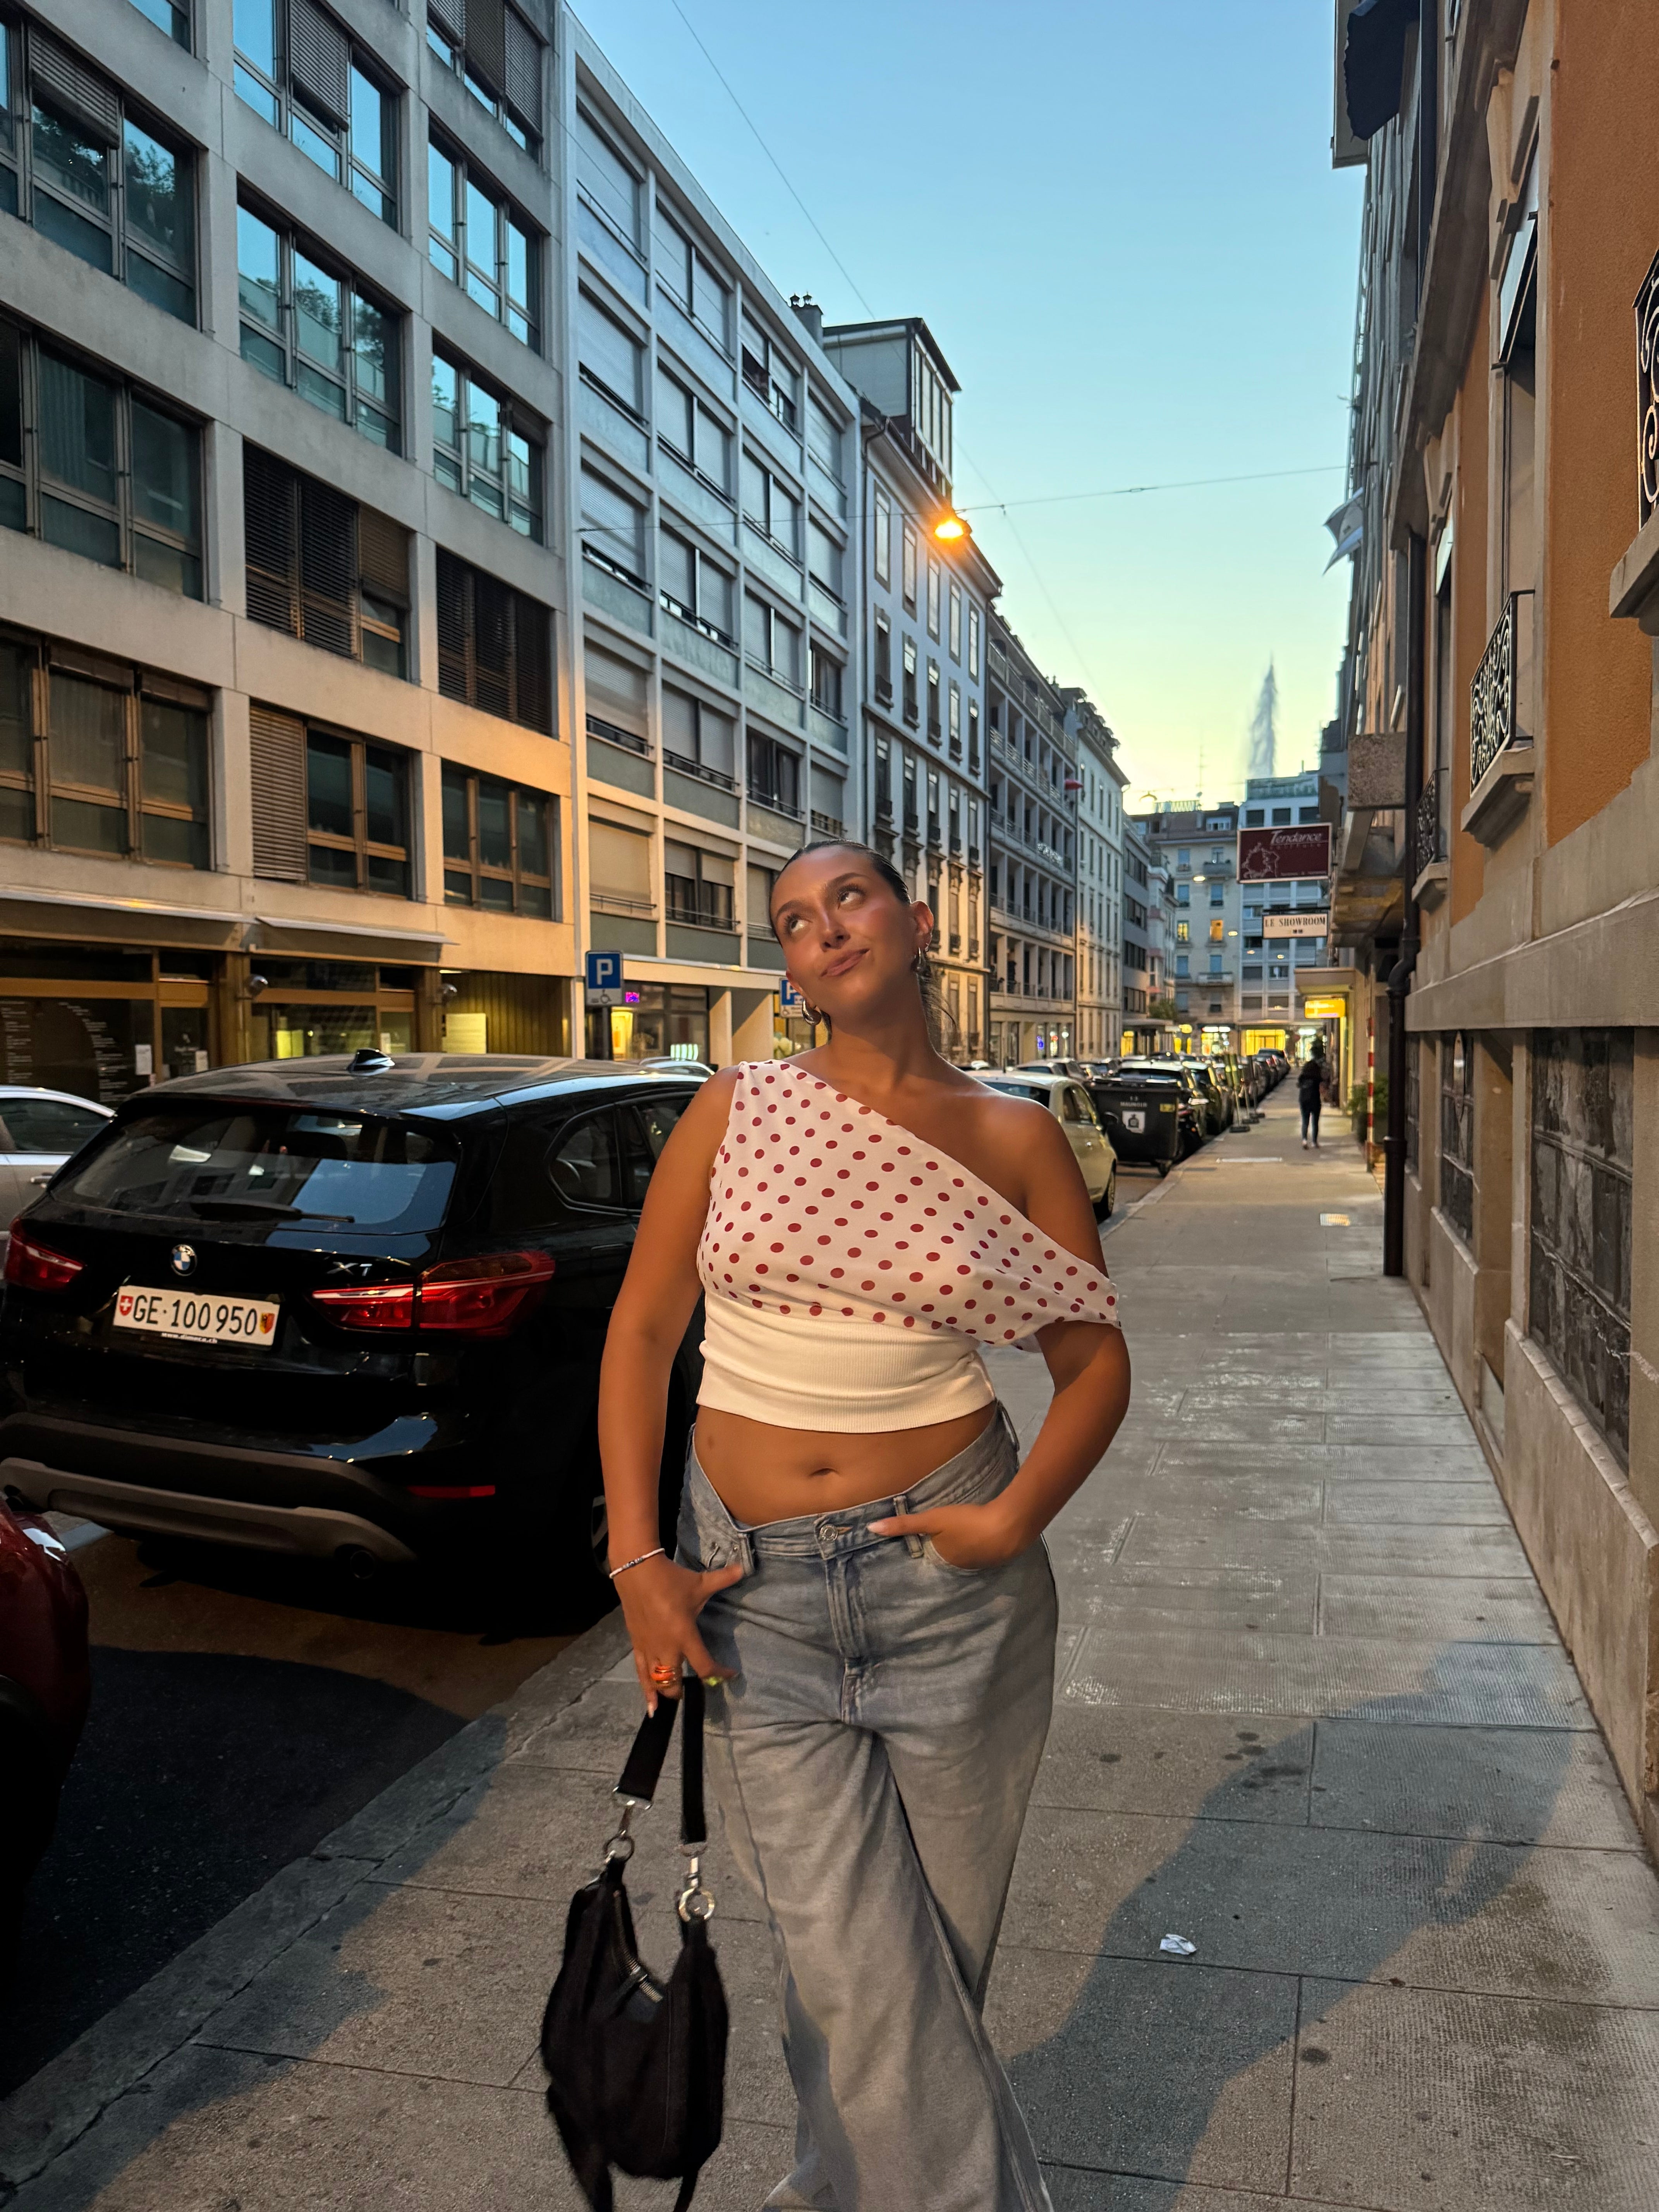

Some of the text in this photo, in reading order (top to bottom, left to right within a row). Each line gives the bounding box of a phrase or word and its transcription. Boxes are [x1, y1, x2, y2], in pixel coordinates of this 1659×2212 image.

[1271, 830, 1322, 844] Tendance
[1265, 917, 1326, 927] LE SHOWROOM
[596, 959, 613, 985] P
